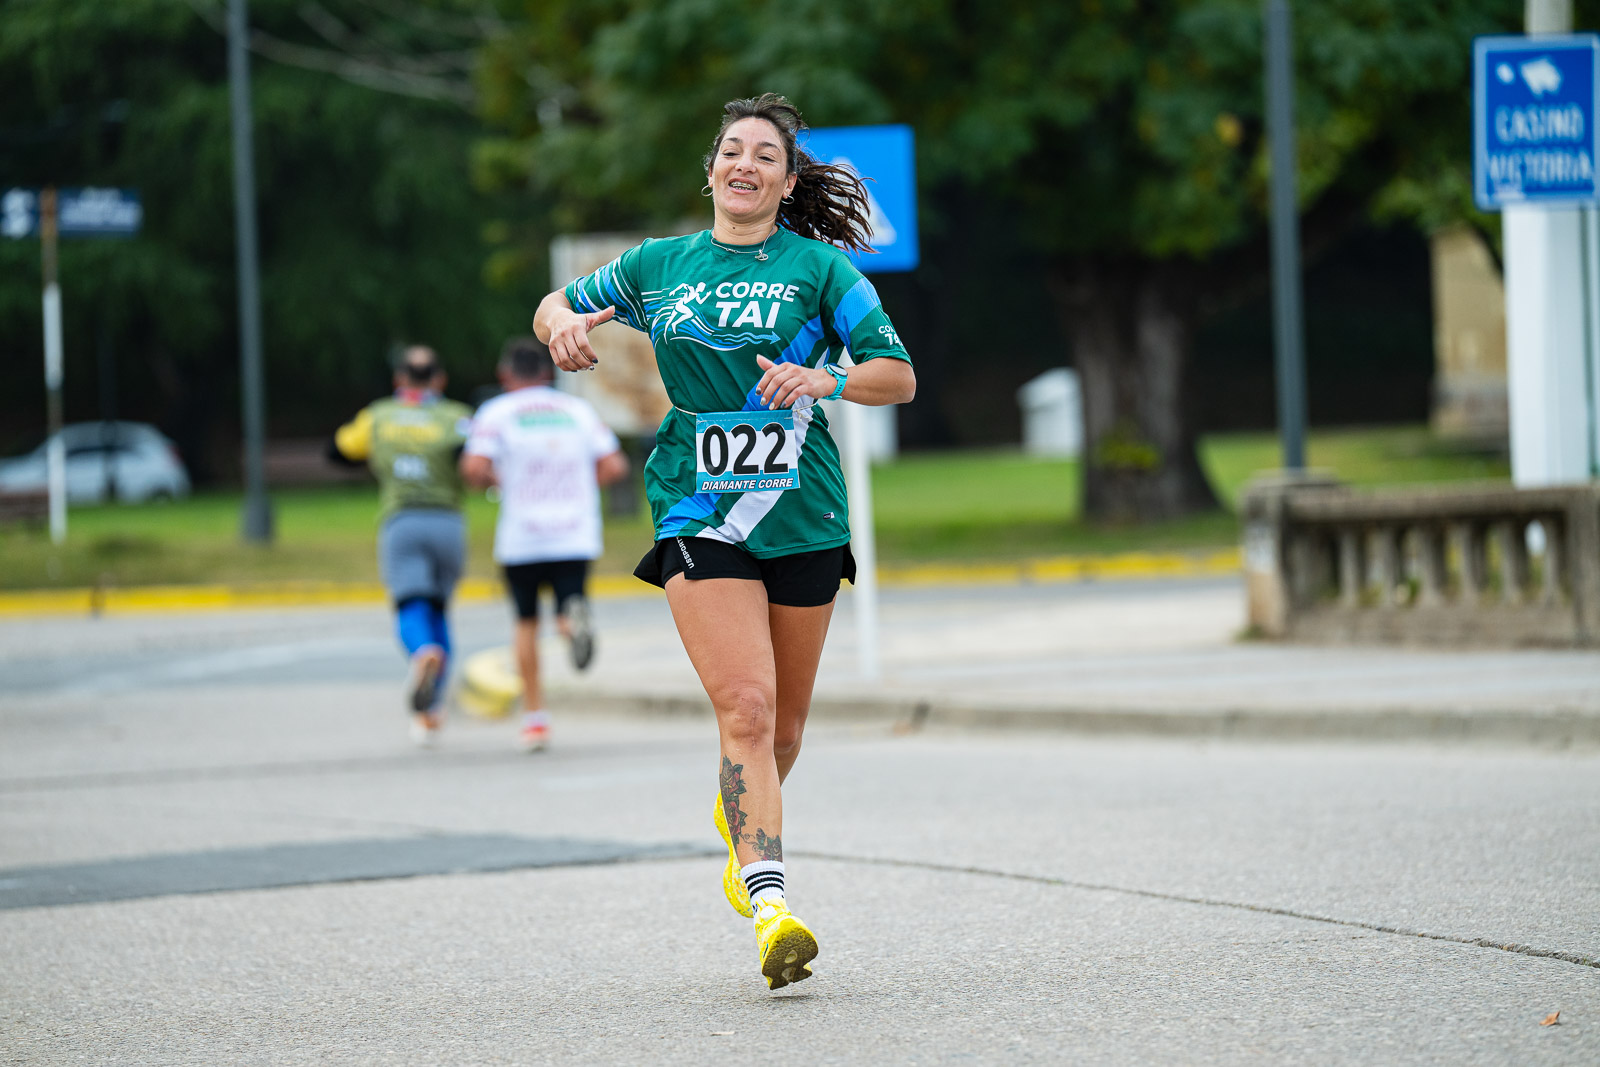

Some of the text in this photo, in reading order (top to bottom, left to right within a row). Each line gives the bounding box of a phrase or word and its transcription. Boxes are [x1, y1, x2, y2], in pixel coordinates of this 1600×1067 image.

[1495, 106, 1584, 143] CASINO
[715, 282, 799, 302] CORRE
[715, 301, 781, 329] TAI
[702, 422, 790, 477] 022
[701, 478, 793, 491] DIAMANTE CORRE
